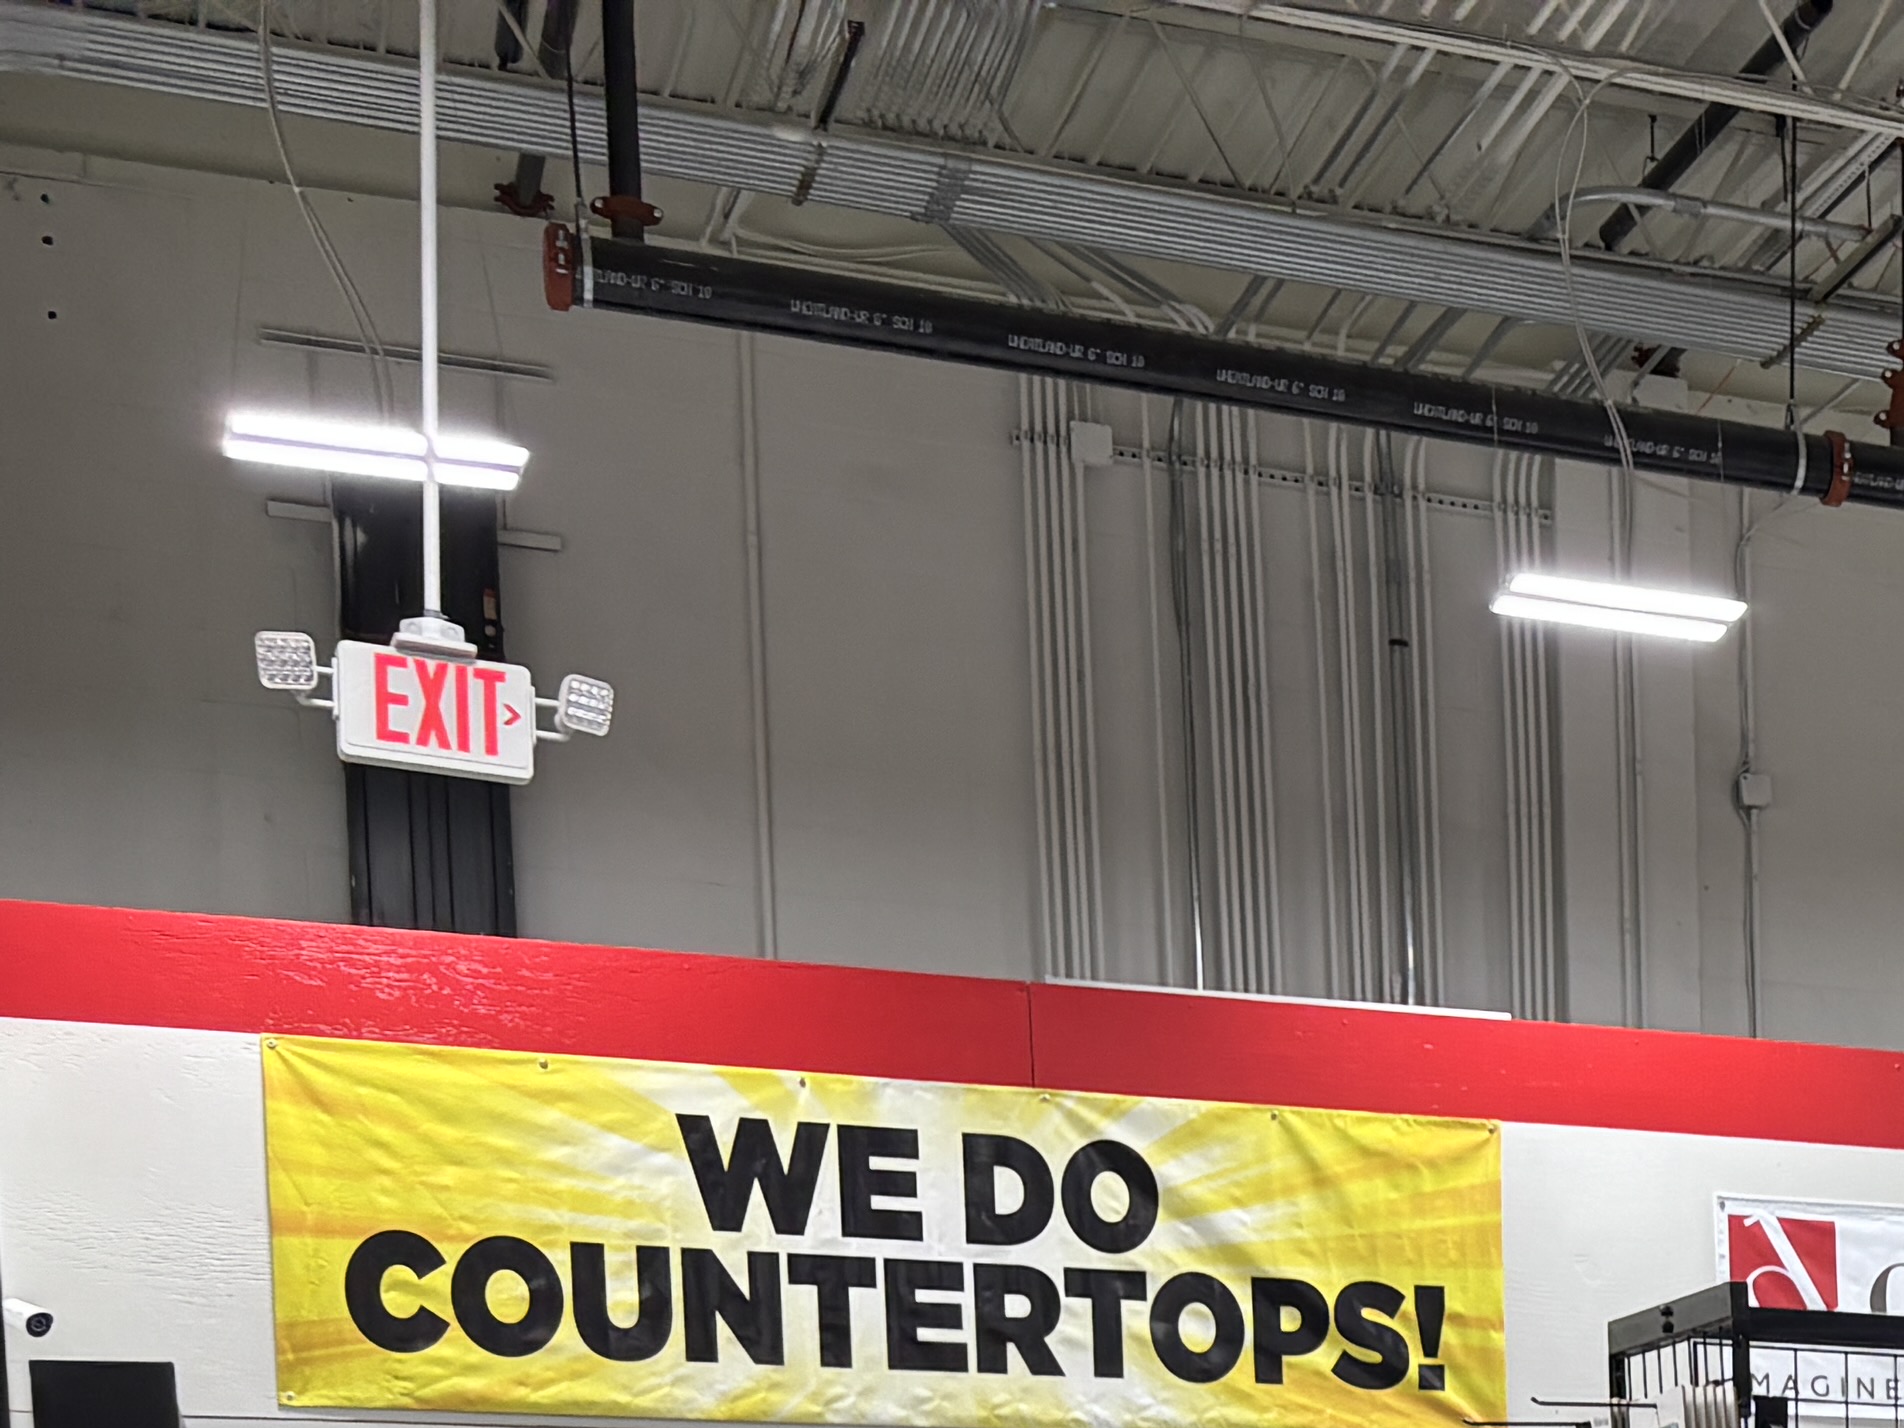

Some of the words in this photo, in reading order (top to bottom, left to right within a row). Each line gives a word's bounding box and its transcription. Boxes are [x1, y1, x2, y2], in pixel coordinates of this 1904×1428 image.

[373, 654, 506, 757] EXIT
[676, 1112, 923, 1243] WE
[961, 1132, 1161, 1255] DO
[343, 1229, 1449, 1392] COUNTERTOPS!
